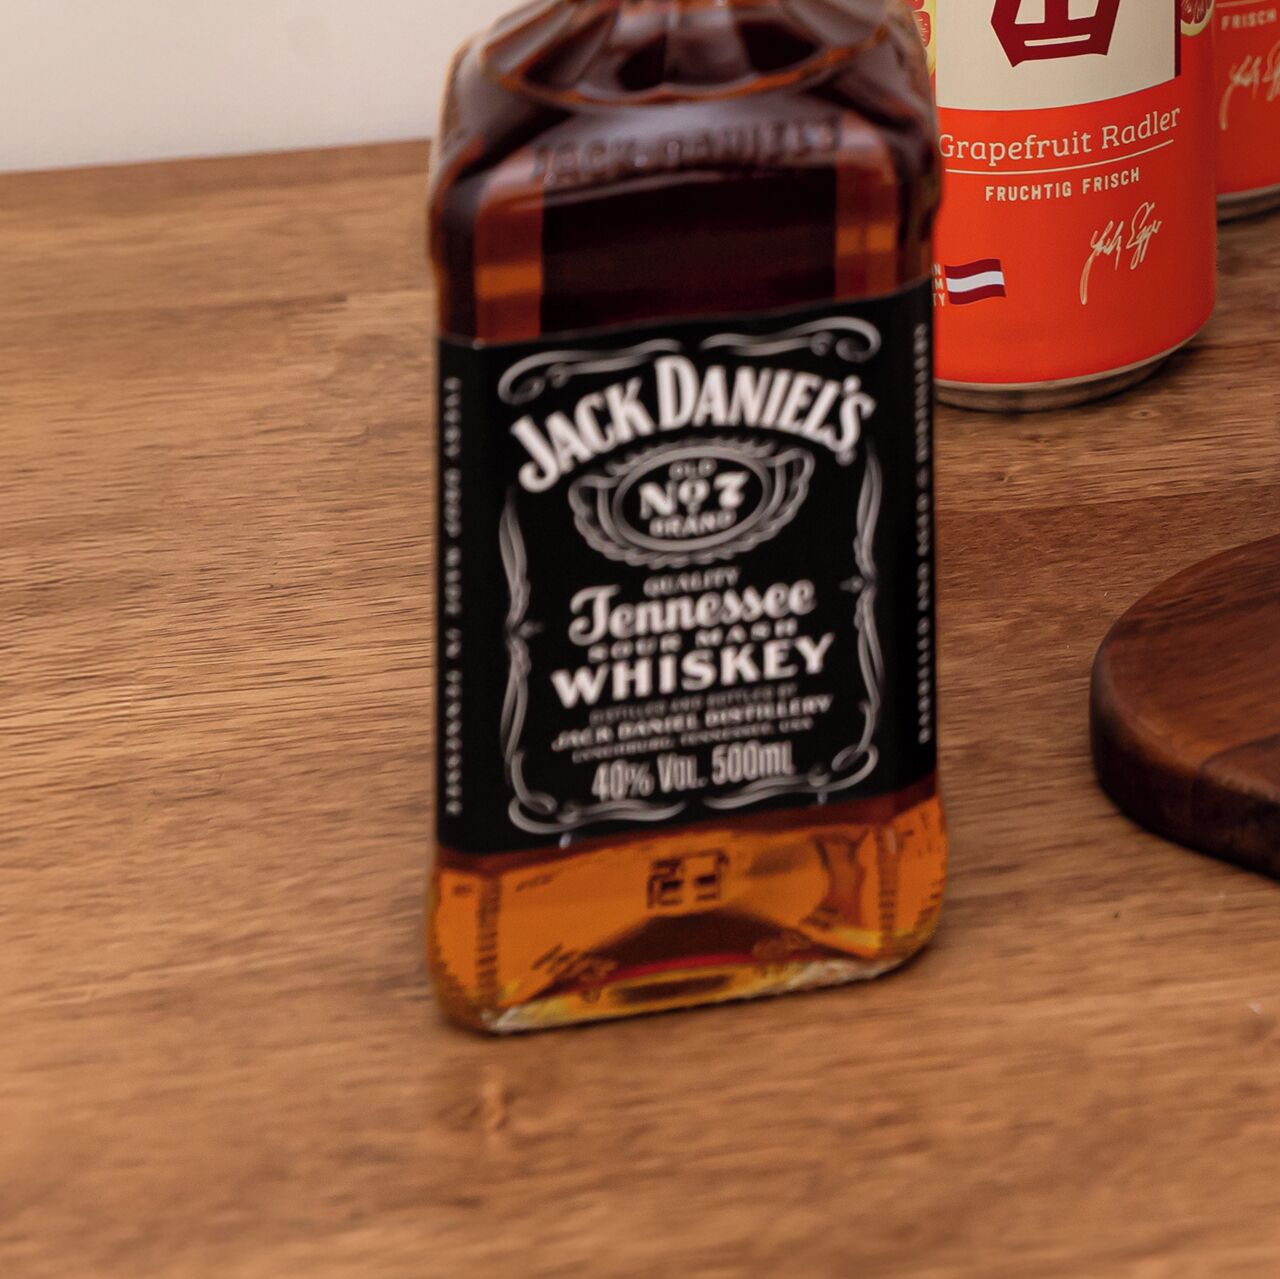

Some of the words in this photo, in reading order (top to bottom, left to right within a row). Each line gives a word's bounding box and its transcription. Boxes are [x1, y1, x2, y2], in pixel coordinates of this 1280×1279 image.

[1221, 8, 1278, 30] FRISCH
[939, 131, 1092, 166] Grapefruit
[1101, 107, 1181, 150] Radler
[985, 181, 1072, 201] FRUCHTIG
[1082, 167, 1140, 194] FRISCH
[510, 376, 656, 493] JACK
[655, 355, 877, 466] DANIEL'S
[643, 566, 740, 597] QUALITY
[568, 579, 817, 646] Tennessee
[550, 632, 836, 709] WHISKEY
[617, 712, 699, 740] DANIEL
[704, 694, 833, 727] DISTILLERY
[591, 759, 656, 801] 40%
